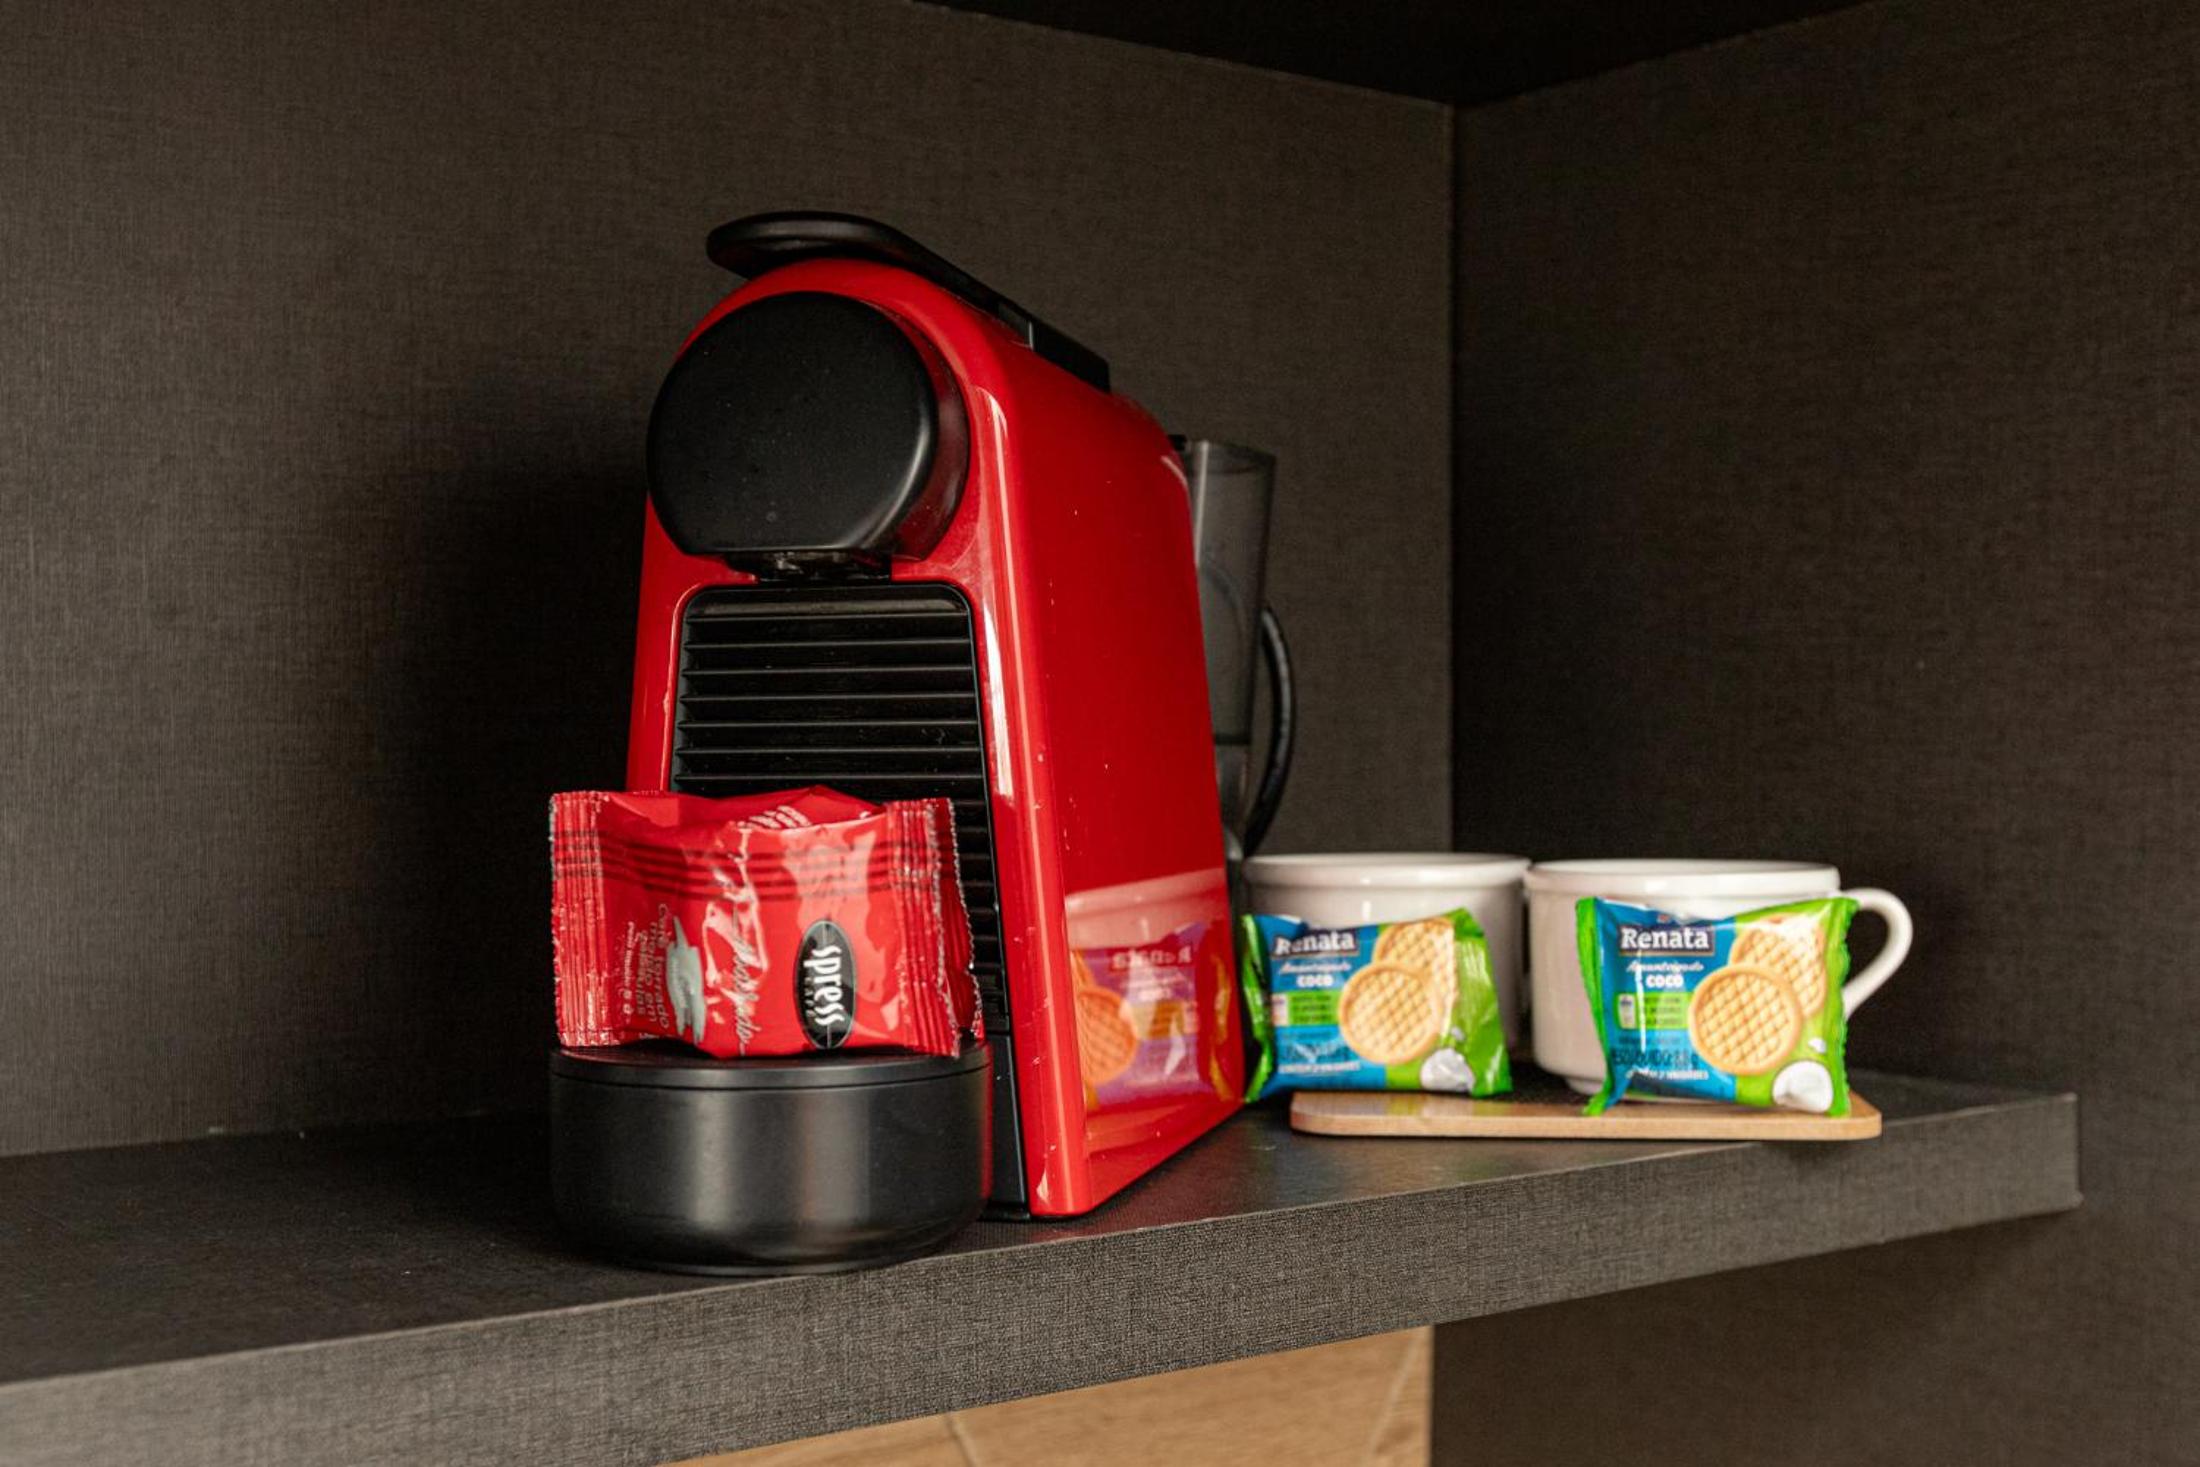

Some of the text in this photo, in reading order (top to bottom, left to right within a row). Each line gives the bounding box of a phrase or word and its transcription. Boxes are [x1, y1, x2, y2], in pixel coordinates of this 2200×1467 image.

[1274, 930, 1355, 955] Renata
[1620, 926, 1710, 950] Renata
[653, 955, 670, 1029] torrado
[803, 944, 845, 1026] spress
